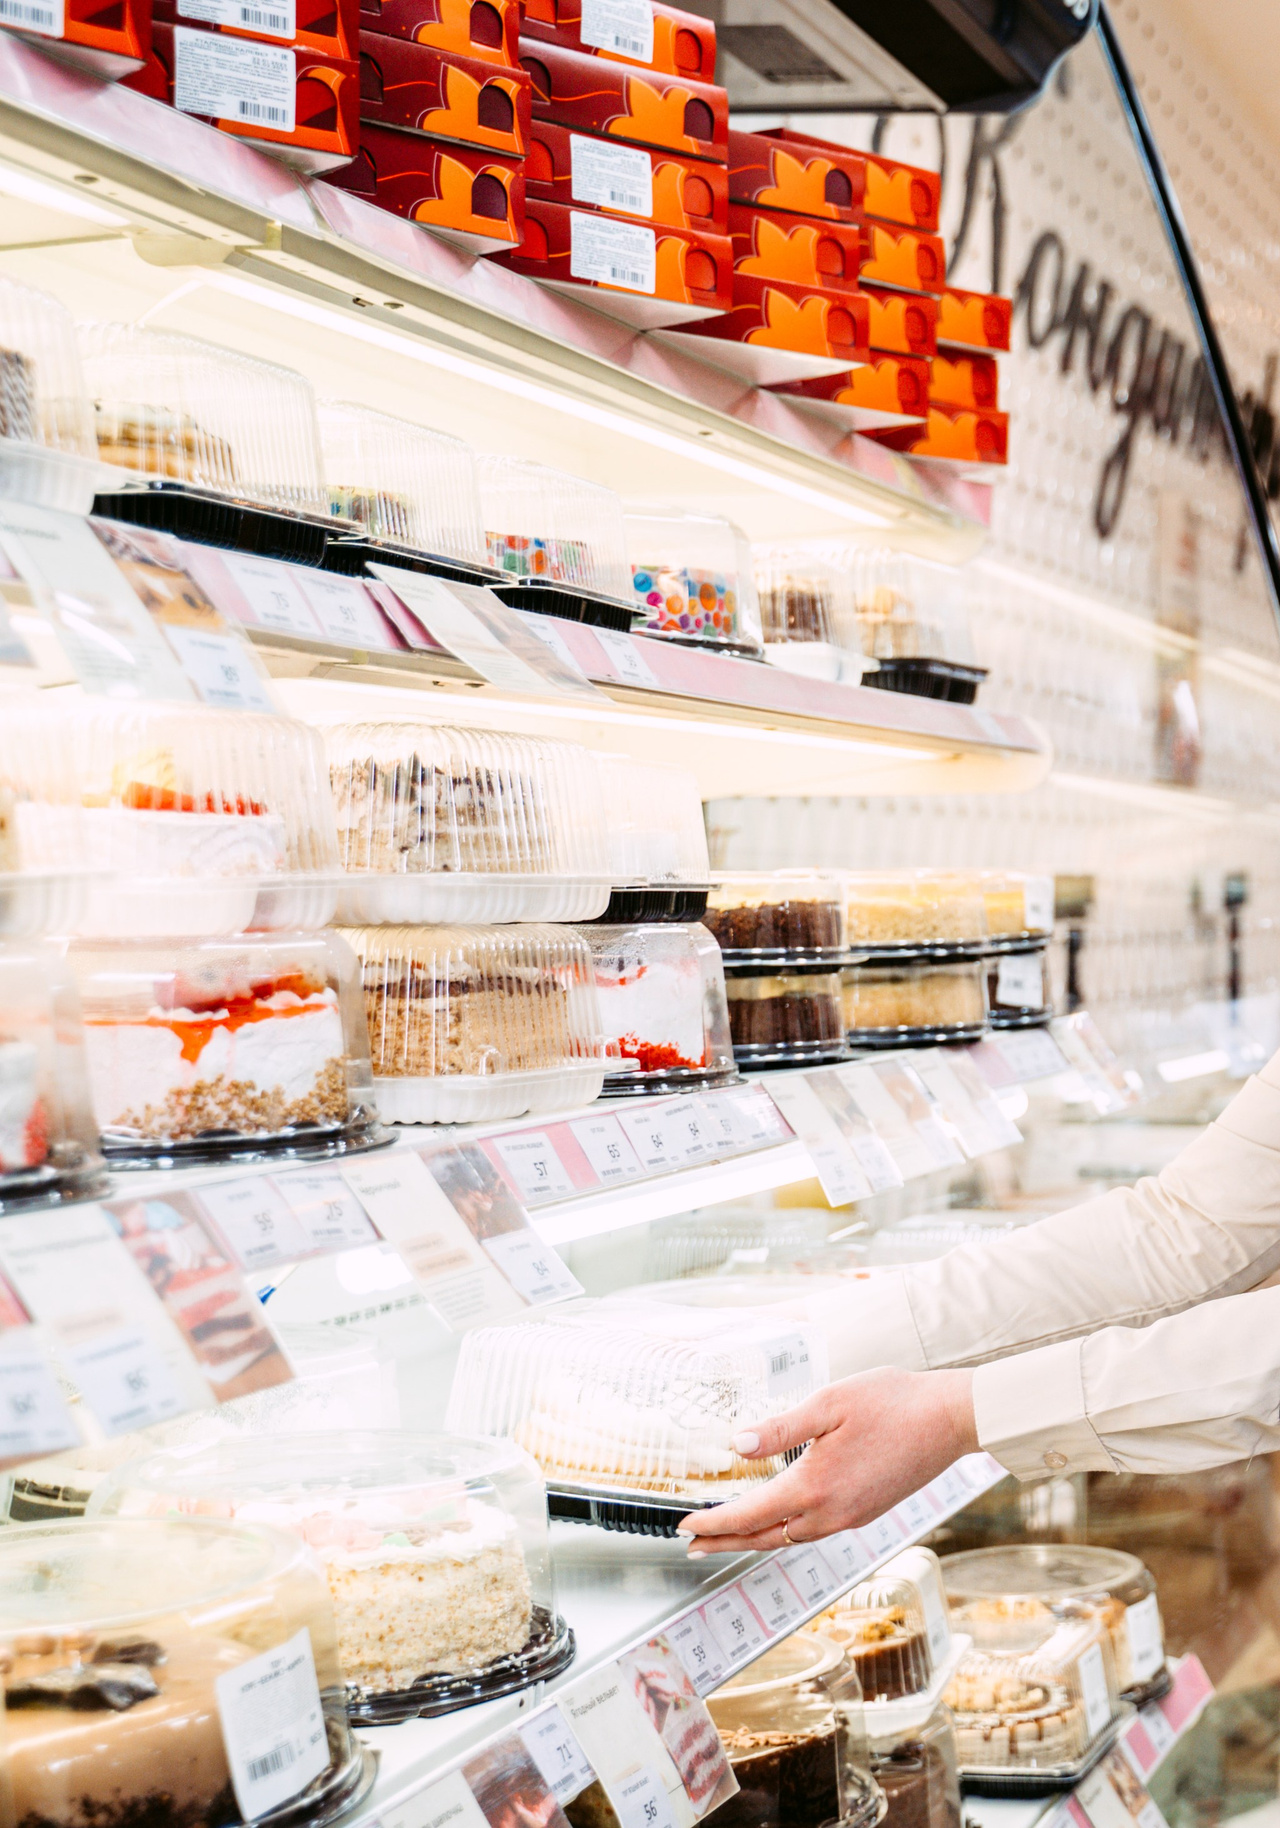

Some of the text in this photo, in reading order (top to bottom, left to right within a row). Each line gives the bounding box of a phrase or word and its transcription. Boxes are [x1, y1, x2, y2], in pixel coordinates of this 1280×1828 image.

[607, 1143, 621, 1159] 65
[533, 1161, 548, 1177] 57
[731, 1618, 745, 1636] 59
[692, 1645, 707, 1663] 59
[556, 1744, 573, 1764] 71
[643, 1800, 658, 1821] 56
